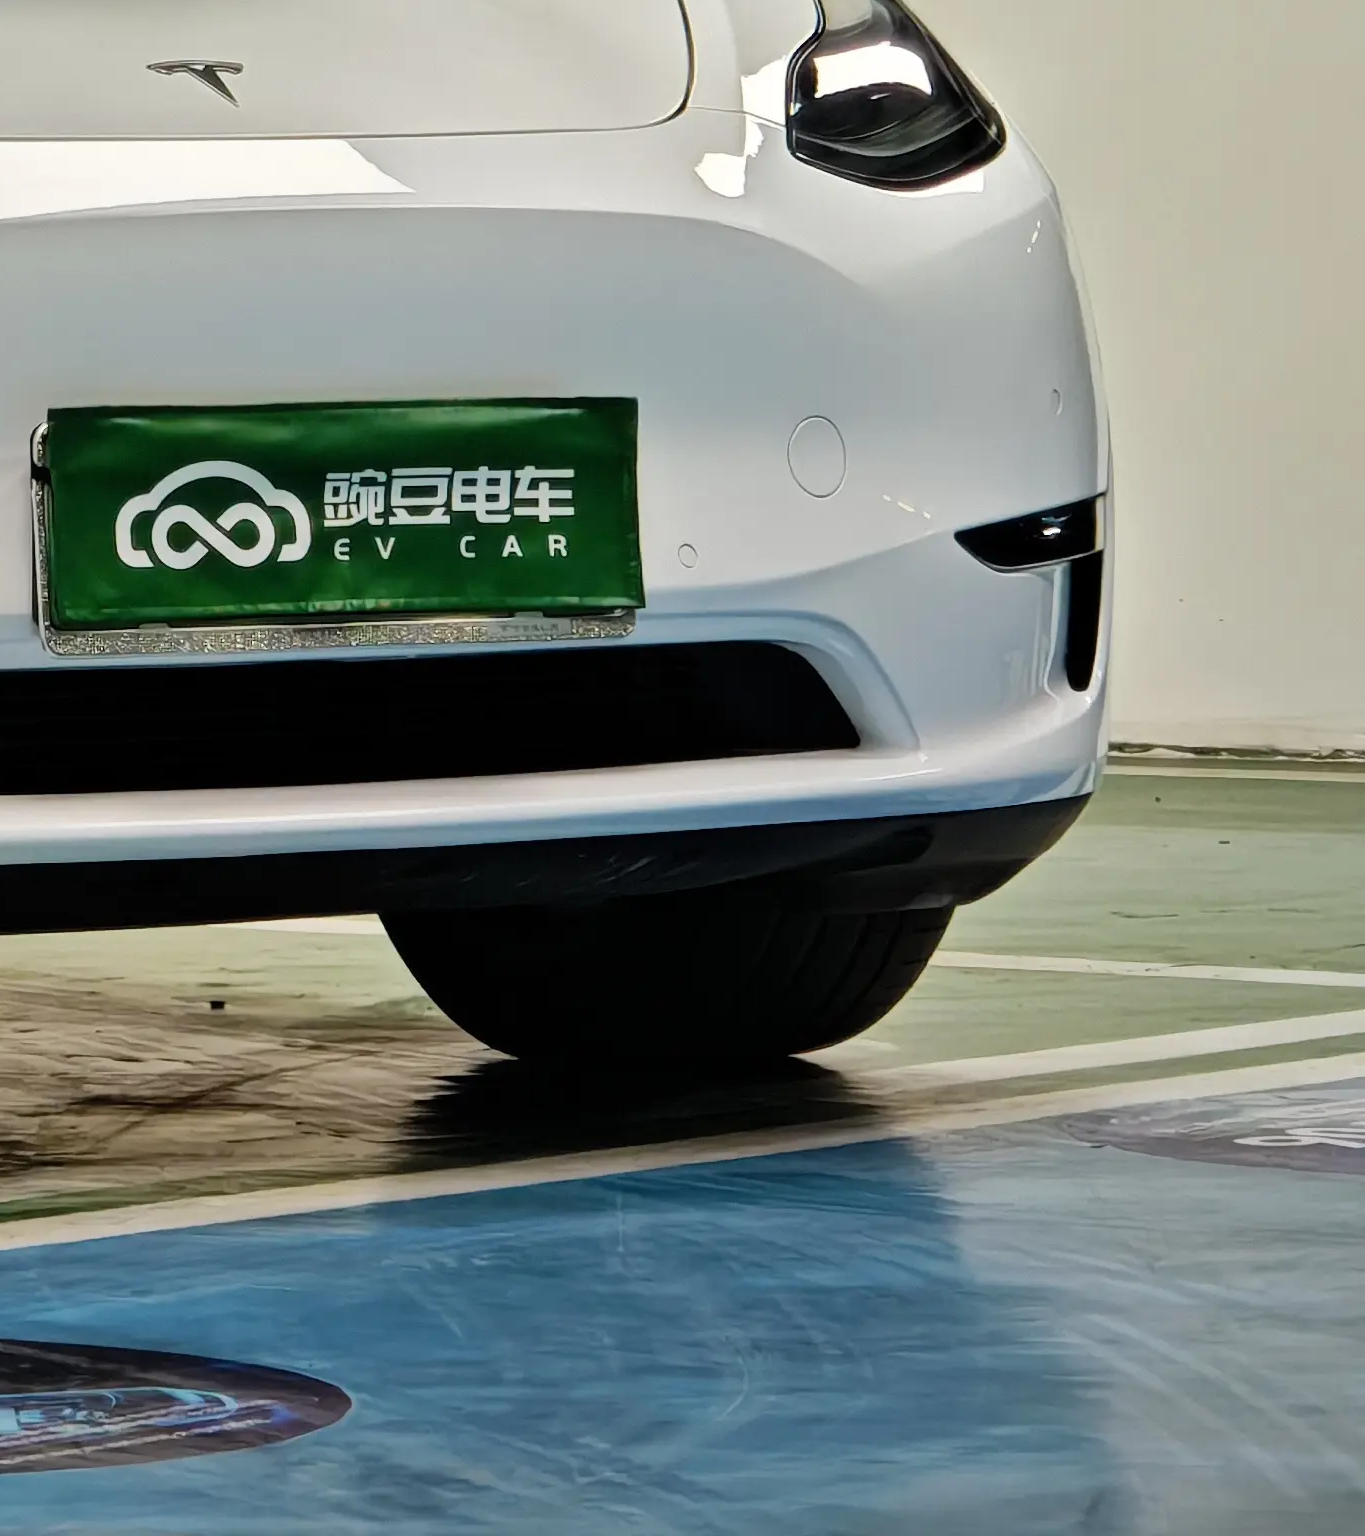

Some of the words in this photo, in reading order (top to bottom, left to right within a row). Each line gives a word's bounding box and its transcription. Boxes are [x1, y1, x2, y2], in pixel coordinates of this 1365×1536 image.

[323, 466, 575, 527] 豌豆电车
[333, 536, 396, 561] EV
[459, 534, 568, 559] CAR
